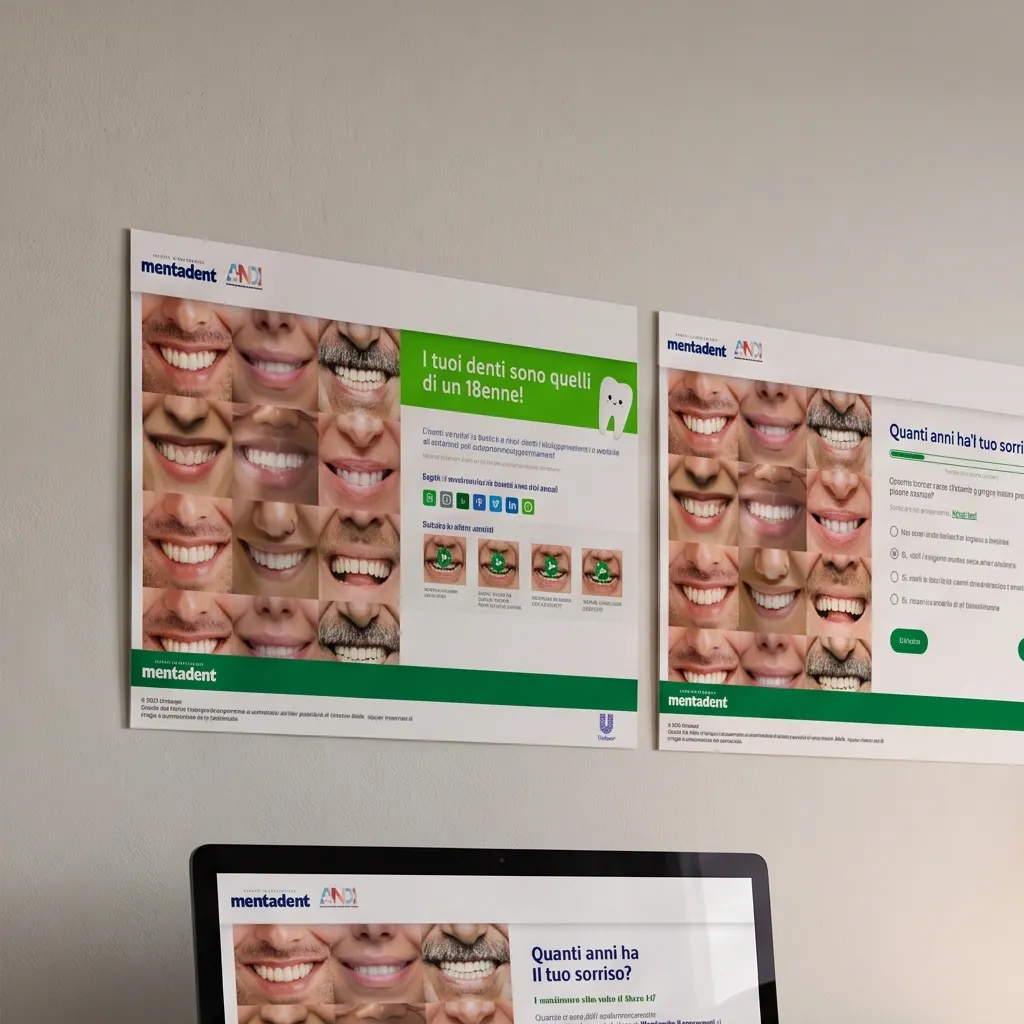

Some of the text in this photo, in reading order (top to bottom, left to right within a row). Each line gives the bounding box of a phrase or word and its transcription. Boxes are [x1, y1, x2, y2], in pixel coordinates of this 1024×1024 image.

[141, 260, 217, 283] mentadent
[667, 339, 727, 358] mentadent
[423, 350, 591, 390] I tuoi denti sono quelli
[423, 374, 524, 404] di un 18enne!
[889, 423, 928, 442] Quanti
[930, 431, 955, 445] anni
[979, 436, 997, 451] tuo
[142, 666, 217, 683] mentadent
[668, 695, 728, 709] mentadent
[231, 894, 310, 908] mentadent
[531, 945, 639, 964] Quanti anni ha
[545, 968, 571, 982] tuo
[575, 965, 632, 982] sorriso?
